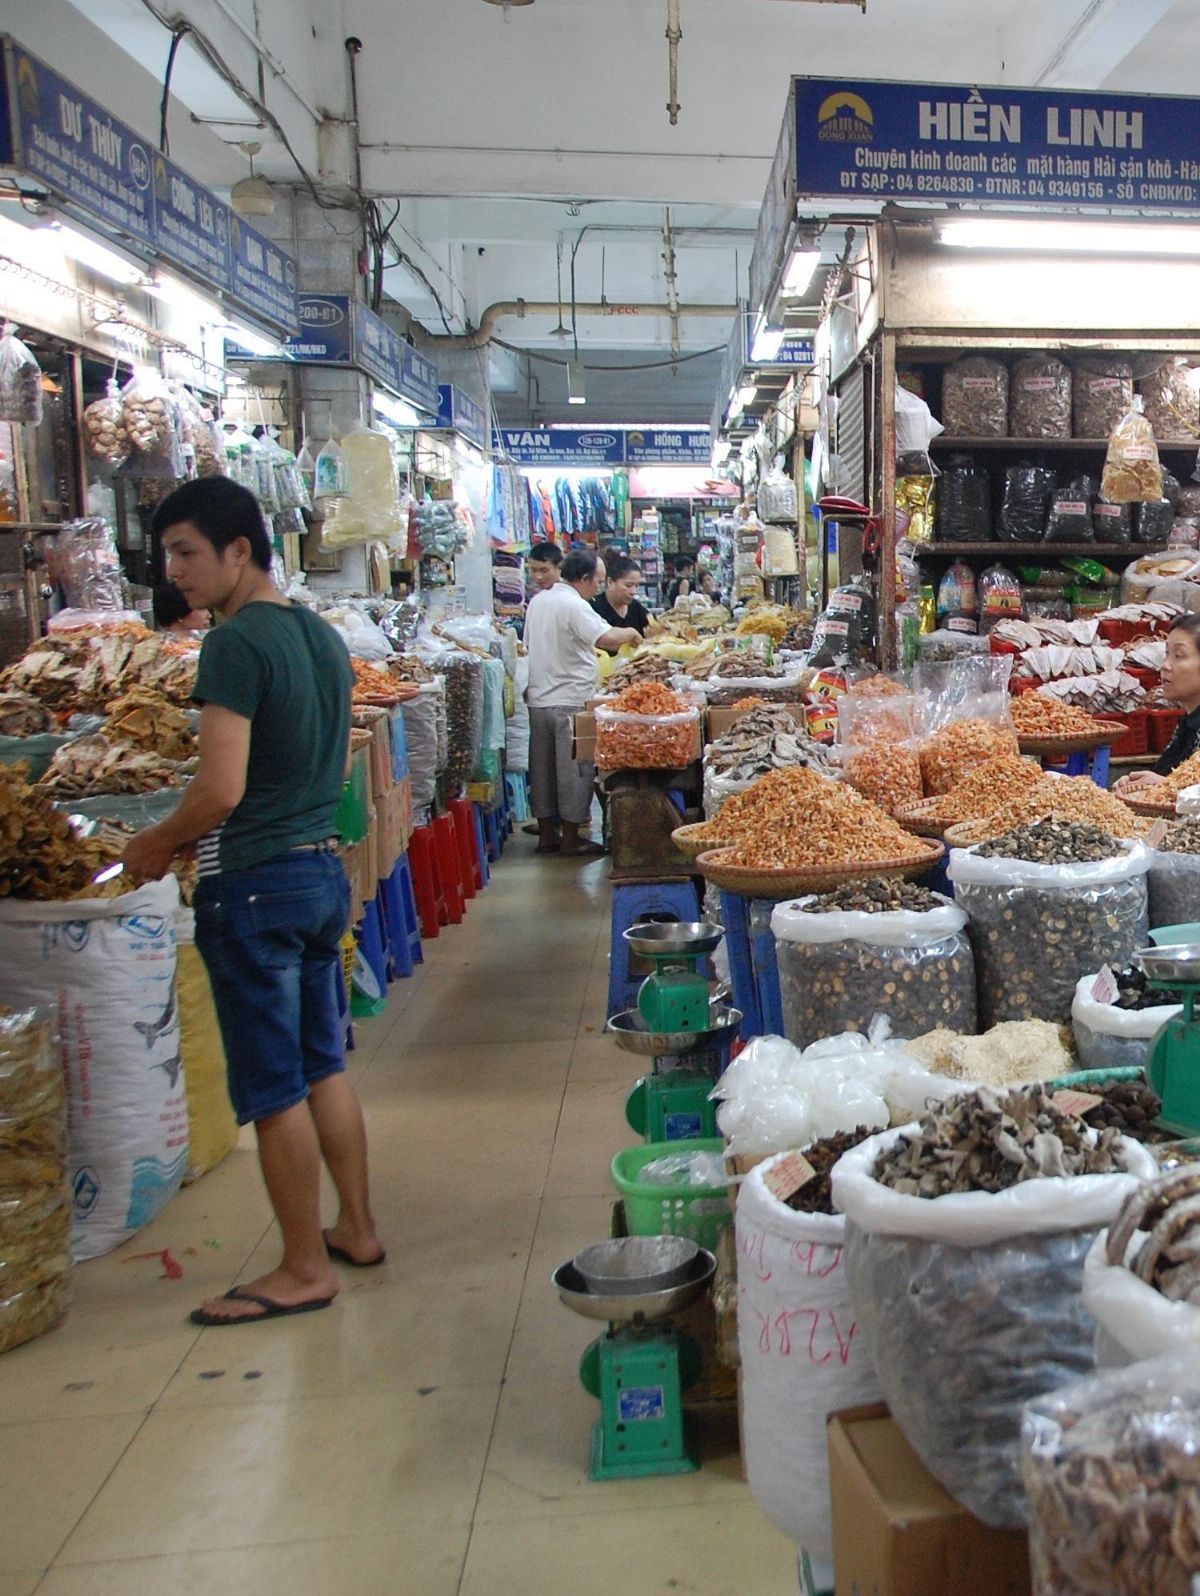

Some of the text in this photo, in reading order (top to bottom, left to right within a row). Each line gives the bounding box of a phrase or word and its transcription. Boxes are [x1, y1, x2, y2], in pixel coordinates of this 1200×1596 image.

[919, 88, 1144, 150] HIỀN LINH
[855, 147, 907, 171] Chuyên
[911, 149, 941, 170] kinh
[946, 151, 988, 173] doanh
[991, 153, 1017, 174] các
[1027, 156, 1054, 179] mặt
[1057, 156, 1090, 178] hàng
[1094, 155, 1116, 178] Hải
[1119, 157, 1143, 179] sản
[1147, 160, 1172, 180] khô
[507, 431, 551, 447] VÂN
